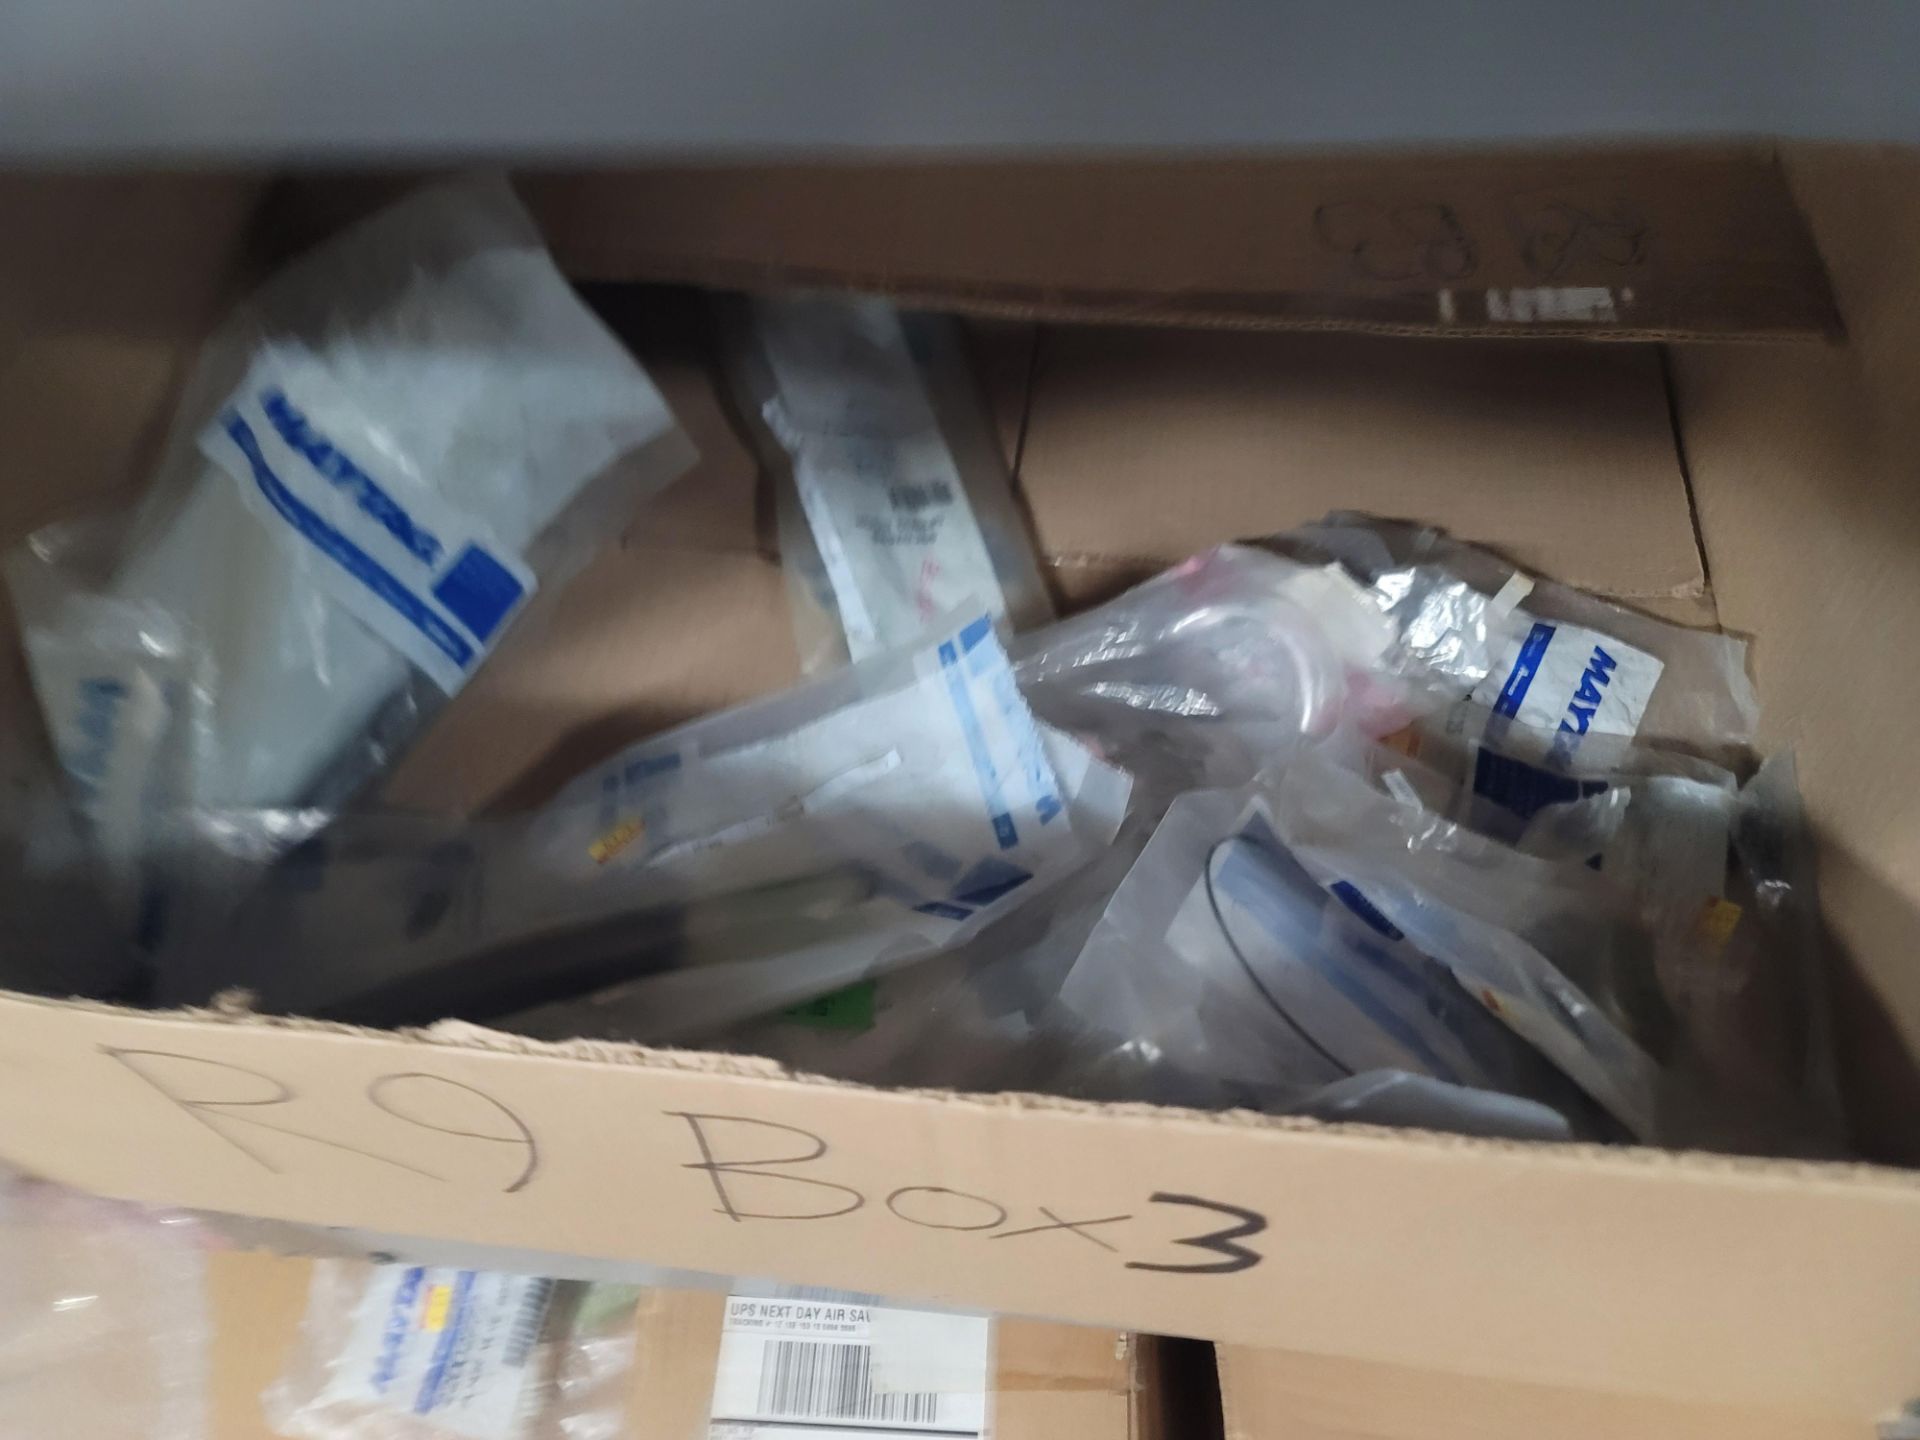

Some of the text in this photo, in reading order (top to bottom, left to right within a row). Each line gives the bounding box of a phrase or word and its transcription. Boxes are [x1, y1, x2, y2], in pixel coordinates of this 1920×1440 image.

[97, 1044, 1268, 1274] R9 Box 3
[730, 1303, 757, 1317] UPS
[760, 1304, 793, 1319] NEXT
[795, 1306, 822, 1321] DAY
[824, 1308, 846, 1322] AIR
